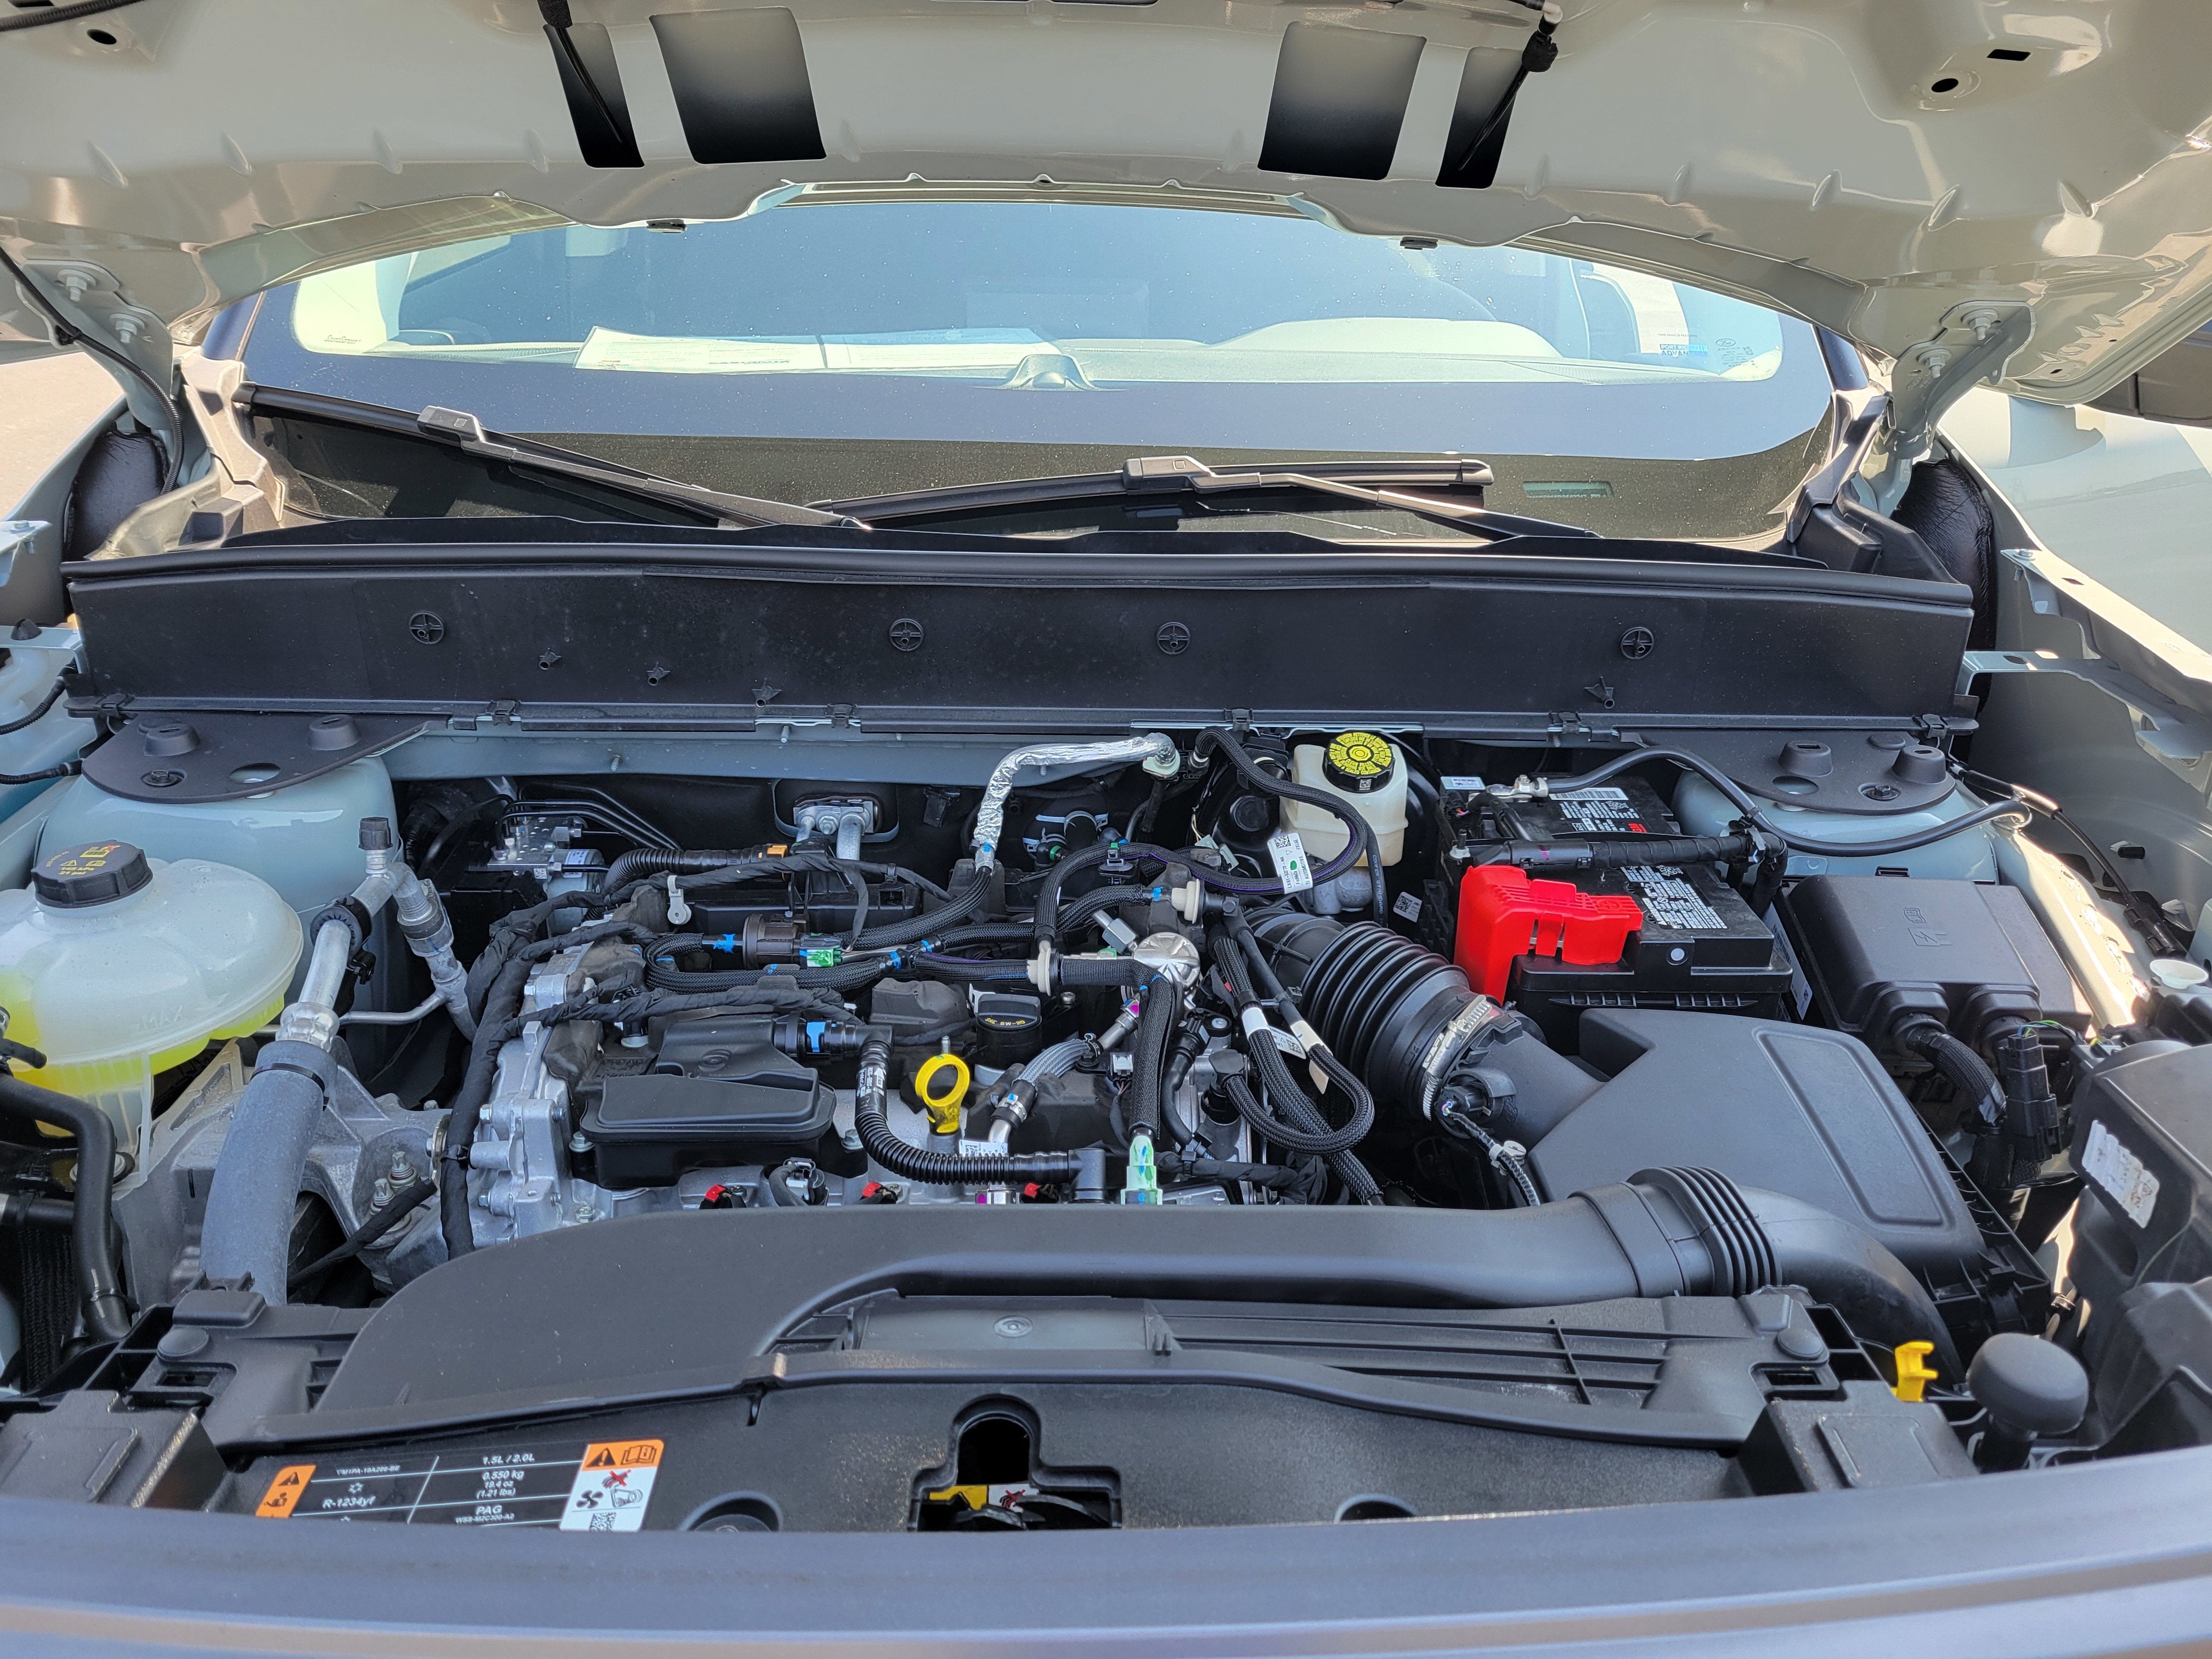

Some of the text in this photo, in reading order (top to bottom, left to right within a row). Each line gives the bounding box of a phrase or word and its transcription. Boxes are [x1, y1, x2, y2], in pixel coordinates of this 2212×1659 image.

[1299, 856, 1310, 879] AUTOMOTIVE
[483, 1454, 535, 1465] 1.5L / 2.0L
[482, 1470, 524, 1481] 0.550 kg
[485, 1481, 501, 1489] 19.4
[499, 1488, 516, 1497] lbs)
[323, 1496, 376, 1508] R-1234yf
[476, 1505, 503, 1515] PAG
